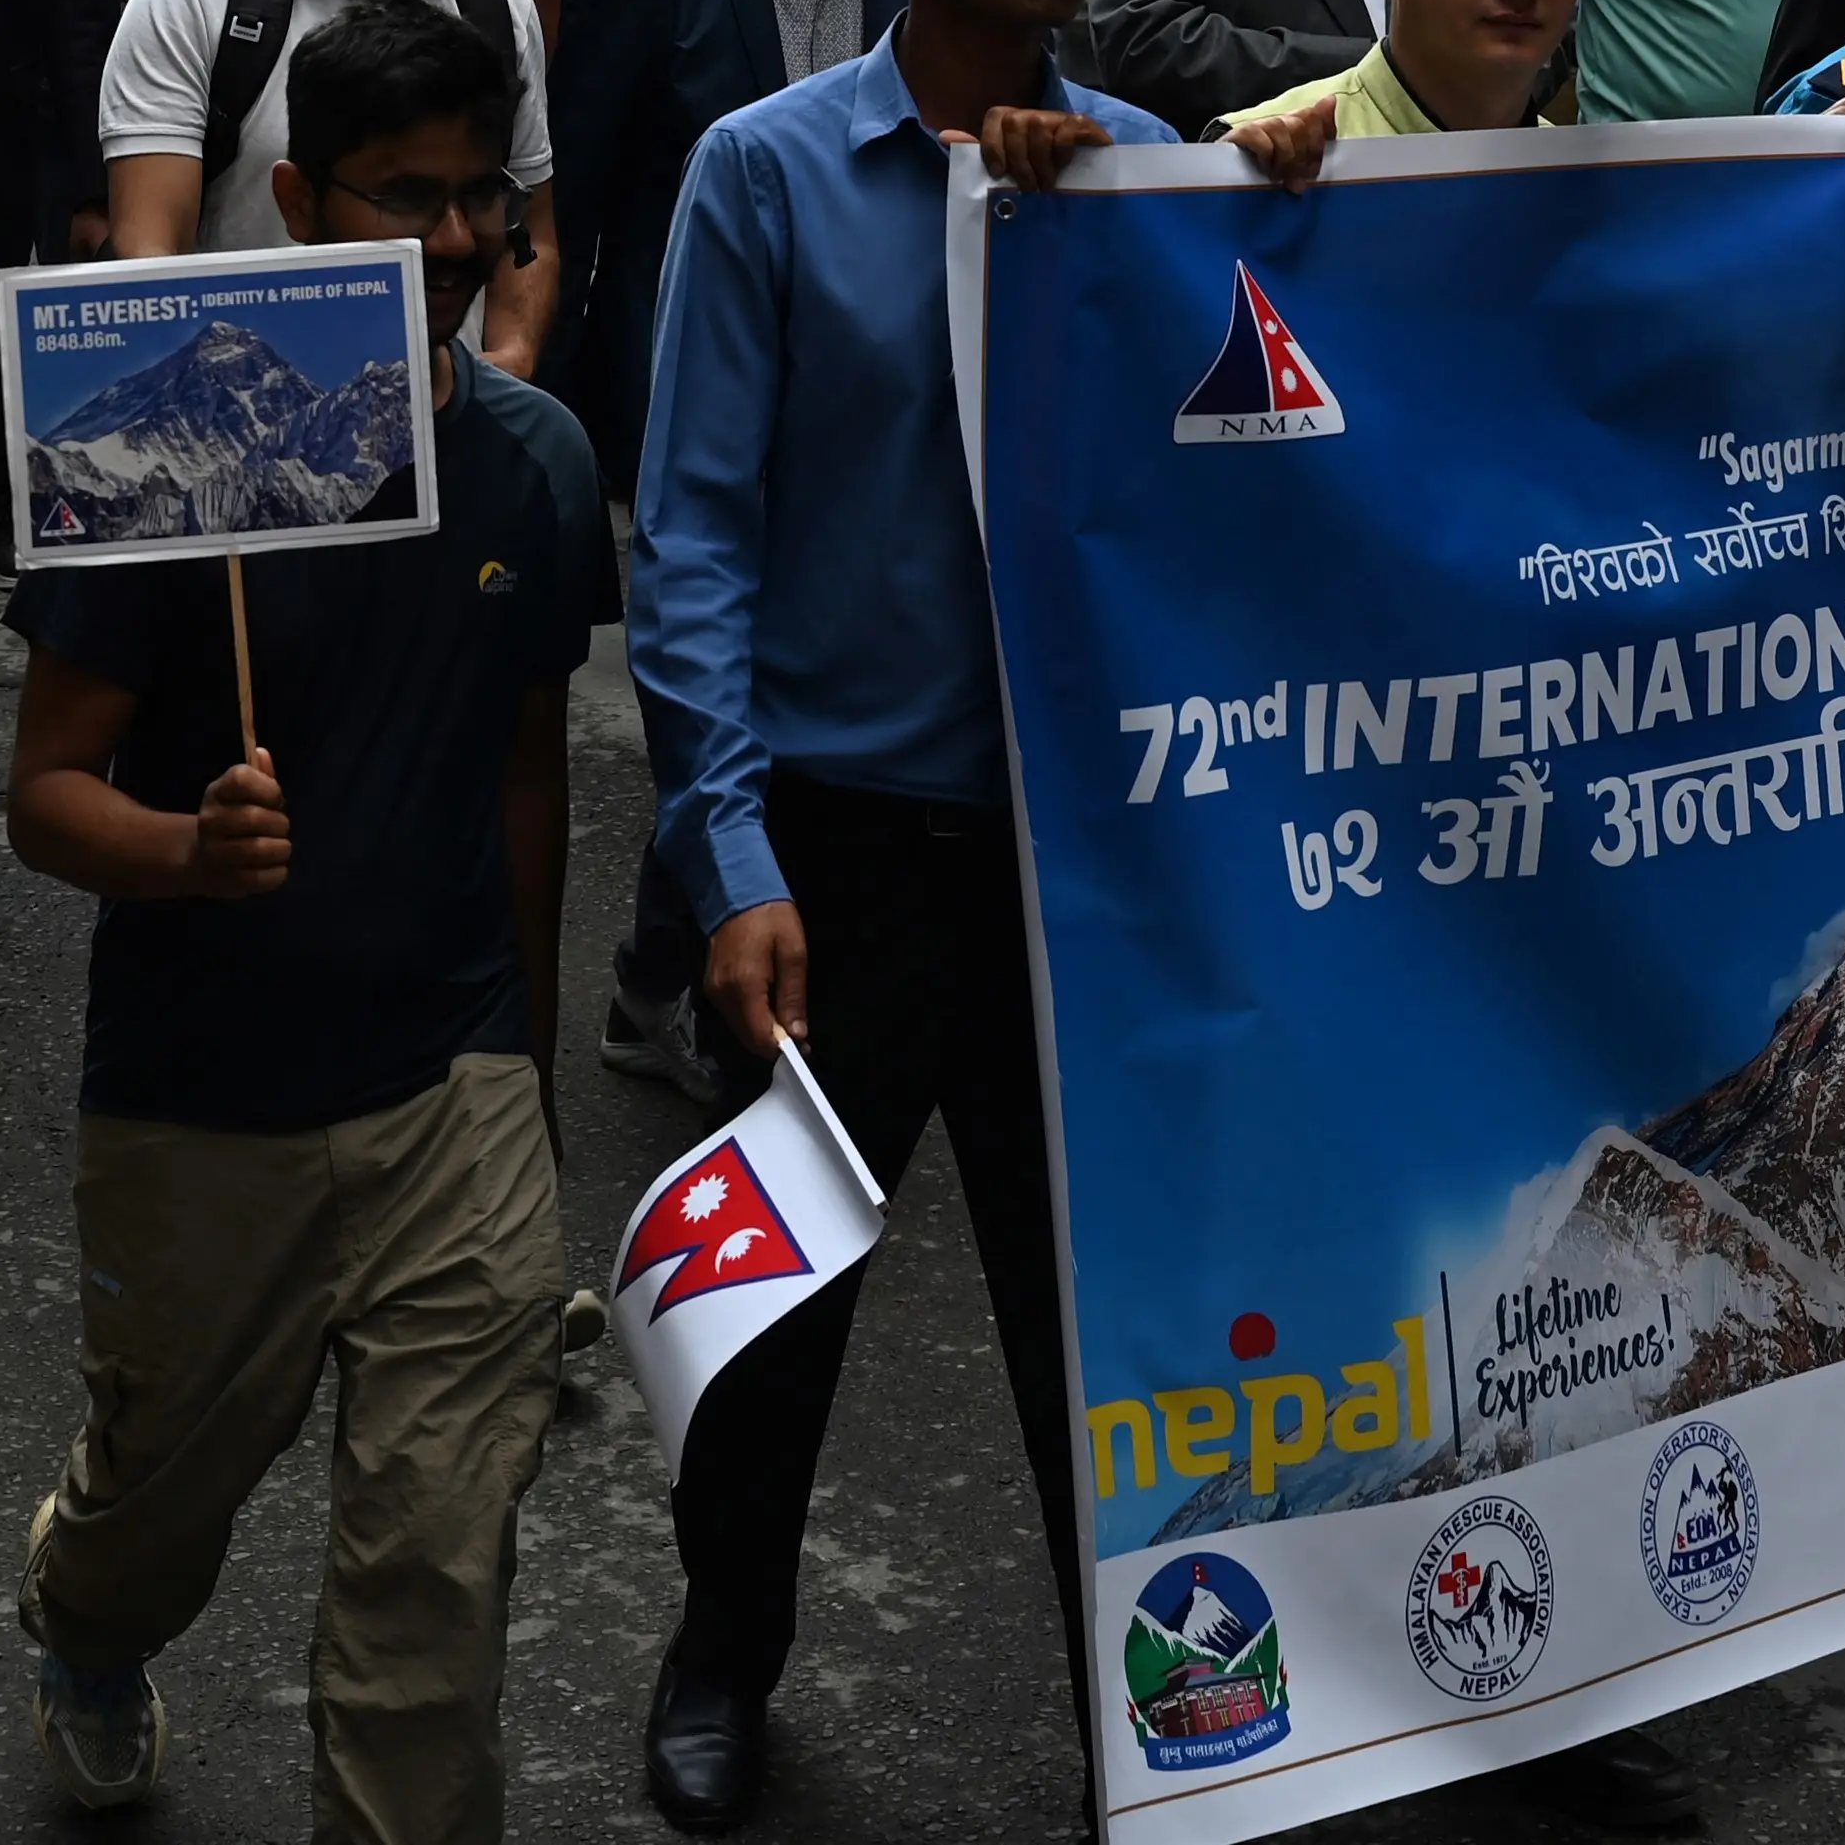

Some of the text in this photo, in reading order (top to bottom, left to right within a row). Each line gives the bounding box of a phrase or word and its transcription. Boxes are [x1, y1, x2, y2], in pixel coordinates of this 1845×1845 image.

[32, 279, 390, 331] MT. EVEREST: IDENTITY & PRIDE OF NEPAL
[35, 329, 127, 353] 8848.86m.
[1219, 414, 1317, 437] NMA
[1684, 500, 1810, 577] सर्वोच्च
[1117, 678, 1290, 807] 72nd
[1280, 807, 1385, 913] ७२
[1495, 1275, 1624, 1360] Lifetime
[1473, 1293, 1679, 1431] Experiences!
[1085, 1315, 1433, 1500] nepal
[1641, 1425, 1760, 1622] EXPEDITION OPERATOR'S ASSOCIATION
[1669, 1537, 1741, 1575] NEPAL
[1414, 1502, 1552, 1670] HIMALAYAN RESCUE ASSOCIATION
[1707, 1564, 1734, 1585] 2008
[1459, 1665, 1522, 1697] NEPAL
